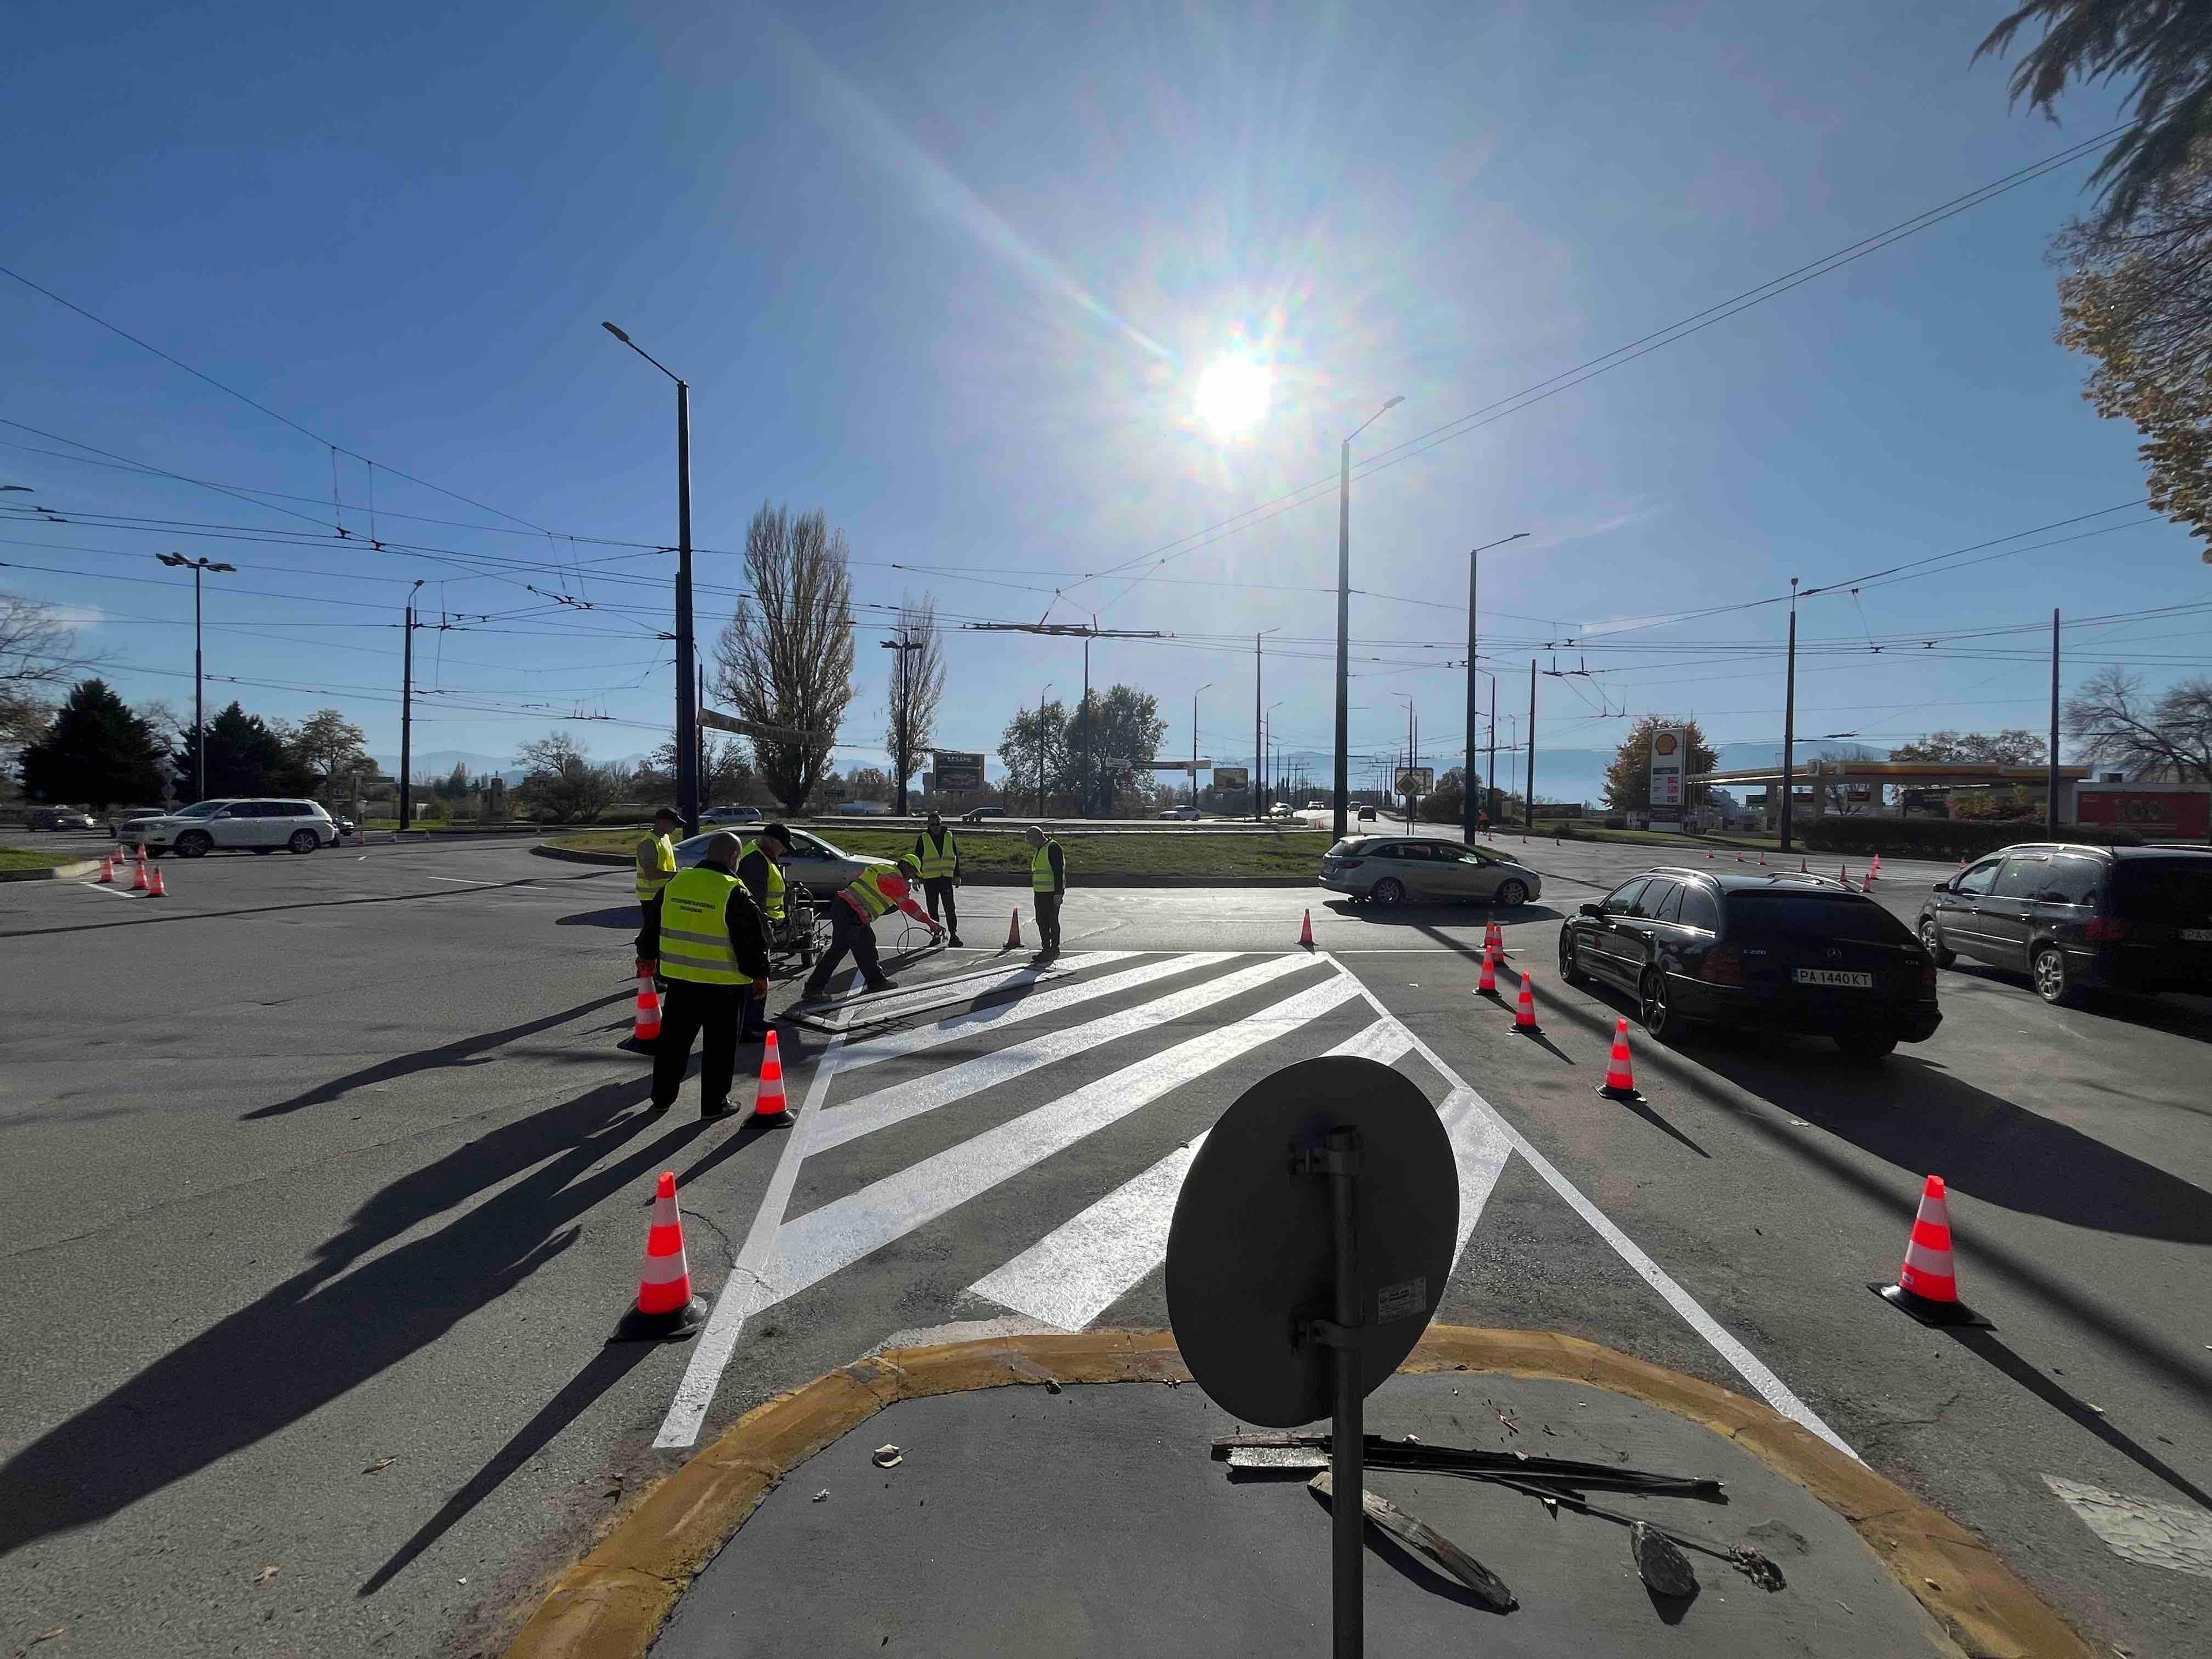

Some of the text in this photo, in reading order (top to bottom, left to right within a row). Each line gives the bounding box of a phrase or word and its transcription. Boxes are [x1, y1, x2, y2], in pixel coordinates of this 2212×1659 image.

[1800, 970, 1869, 986] PA 1440 KT
